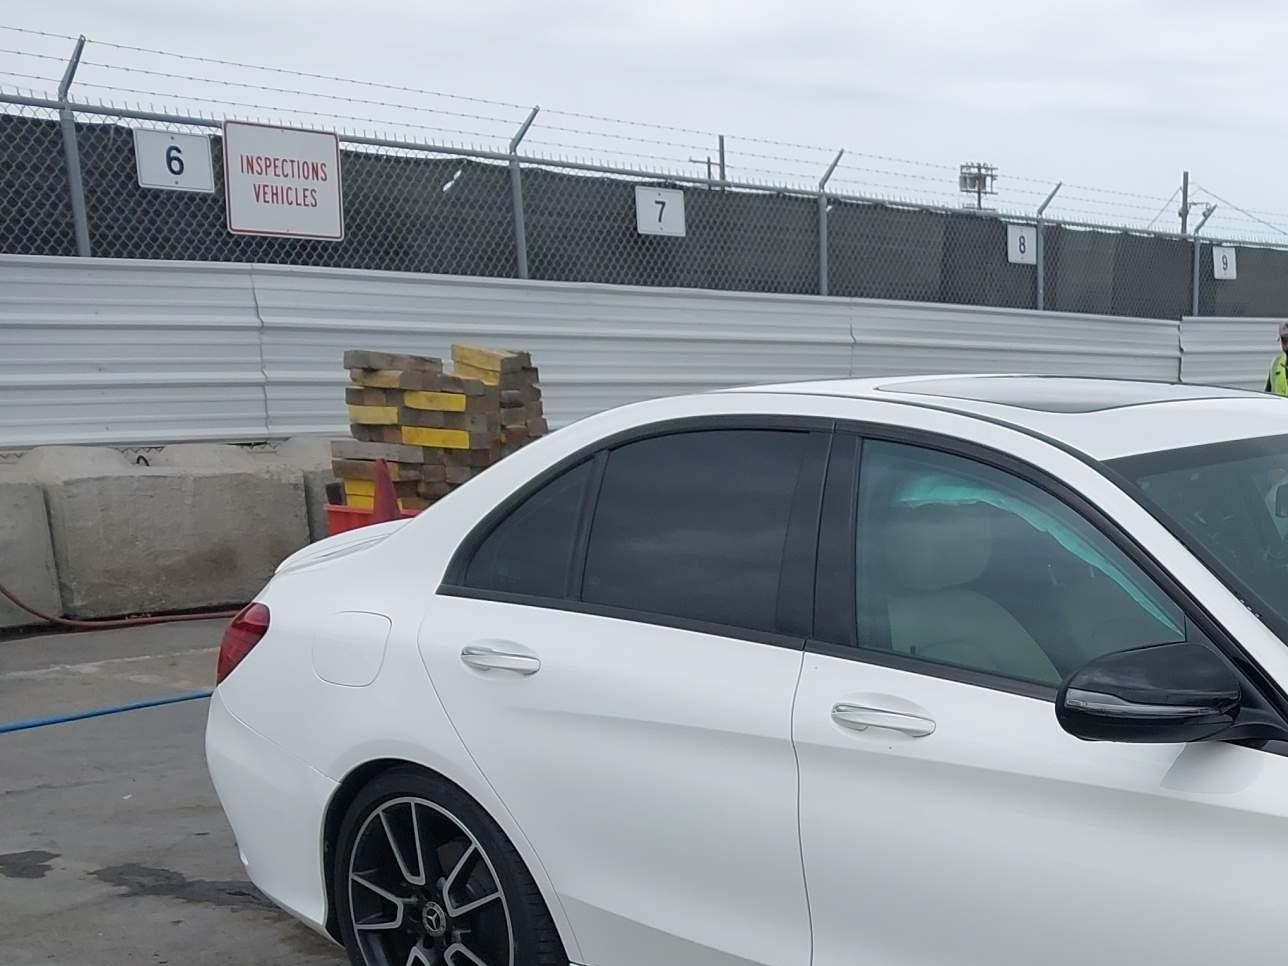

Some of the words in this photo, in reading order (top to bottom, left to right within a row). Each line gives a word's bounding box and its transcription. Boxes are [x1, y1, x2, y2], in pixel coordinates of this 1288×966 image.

[165, 145, 185, 176] 6
[240, 154, 328, 182] INSPECTIONS
[253, 183, 318, 208] VEHICLES
[654, 199, 666, 223] 7
[1018, 235, 1026, 254] 8
[1221, 254, 1228, 271] 9
